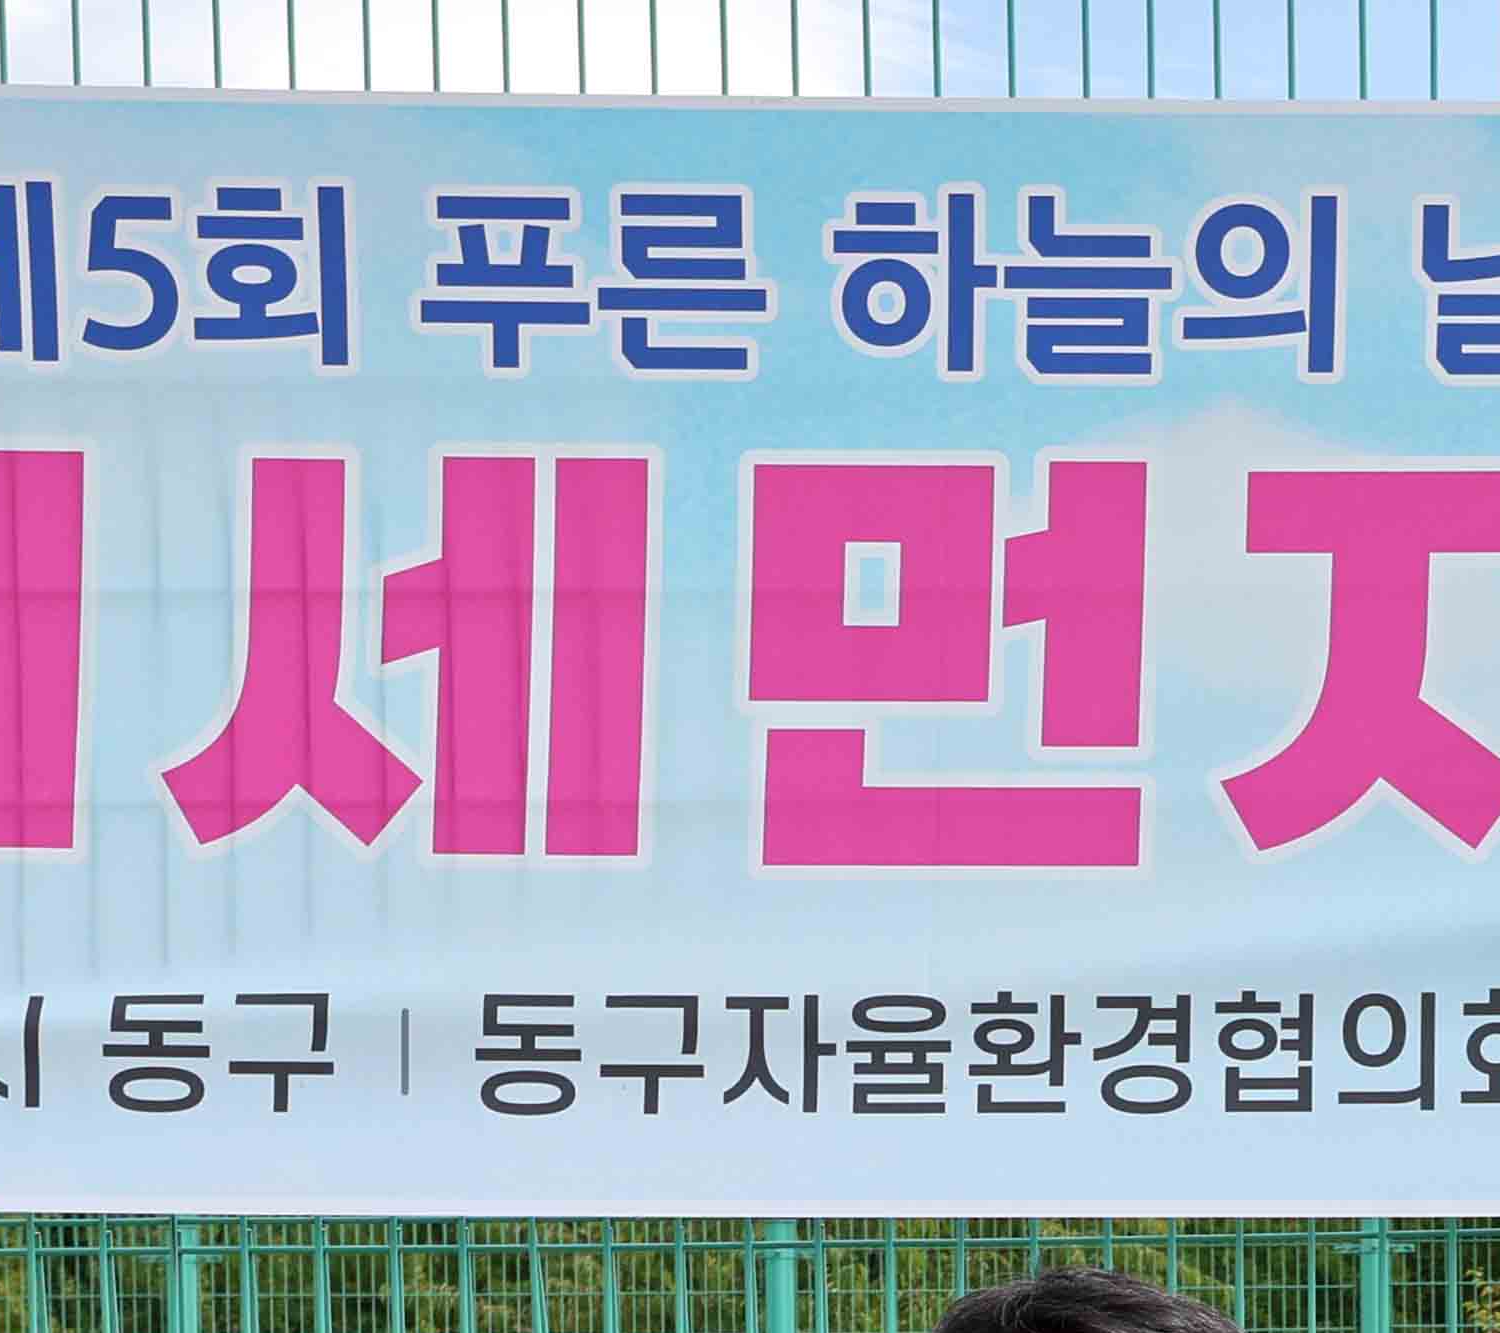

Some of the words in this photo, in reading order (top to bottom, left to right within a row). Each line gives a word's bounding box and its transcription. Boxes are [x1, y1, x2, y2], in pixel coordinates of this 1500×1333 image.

[421, 194, 766, 369] 푸른
[835, 194, 1337, 374] 하늘의
[103, 994, 333, 1112] 동구
